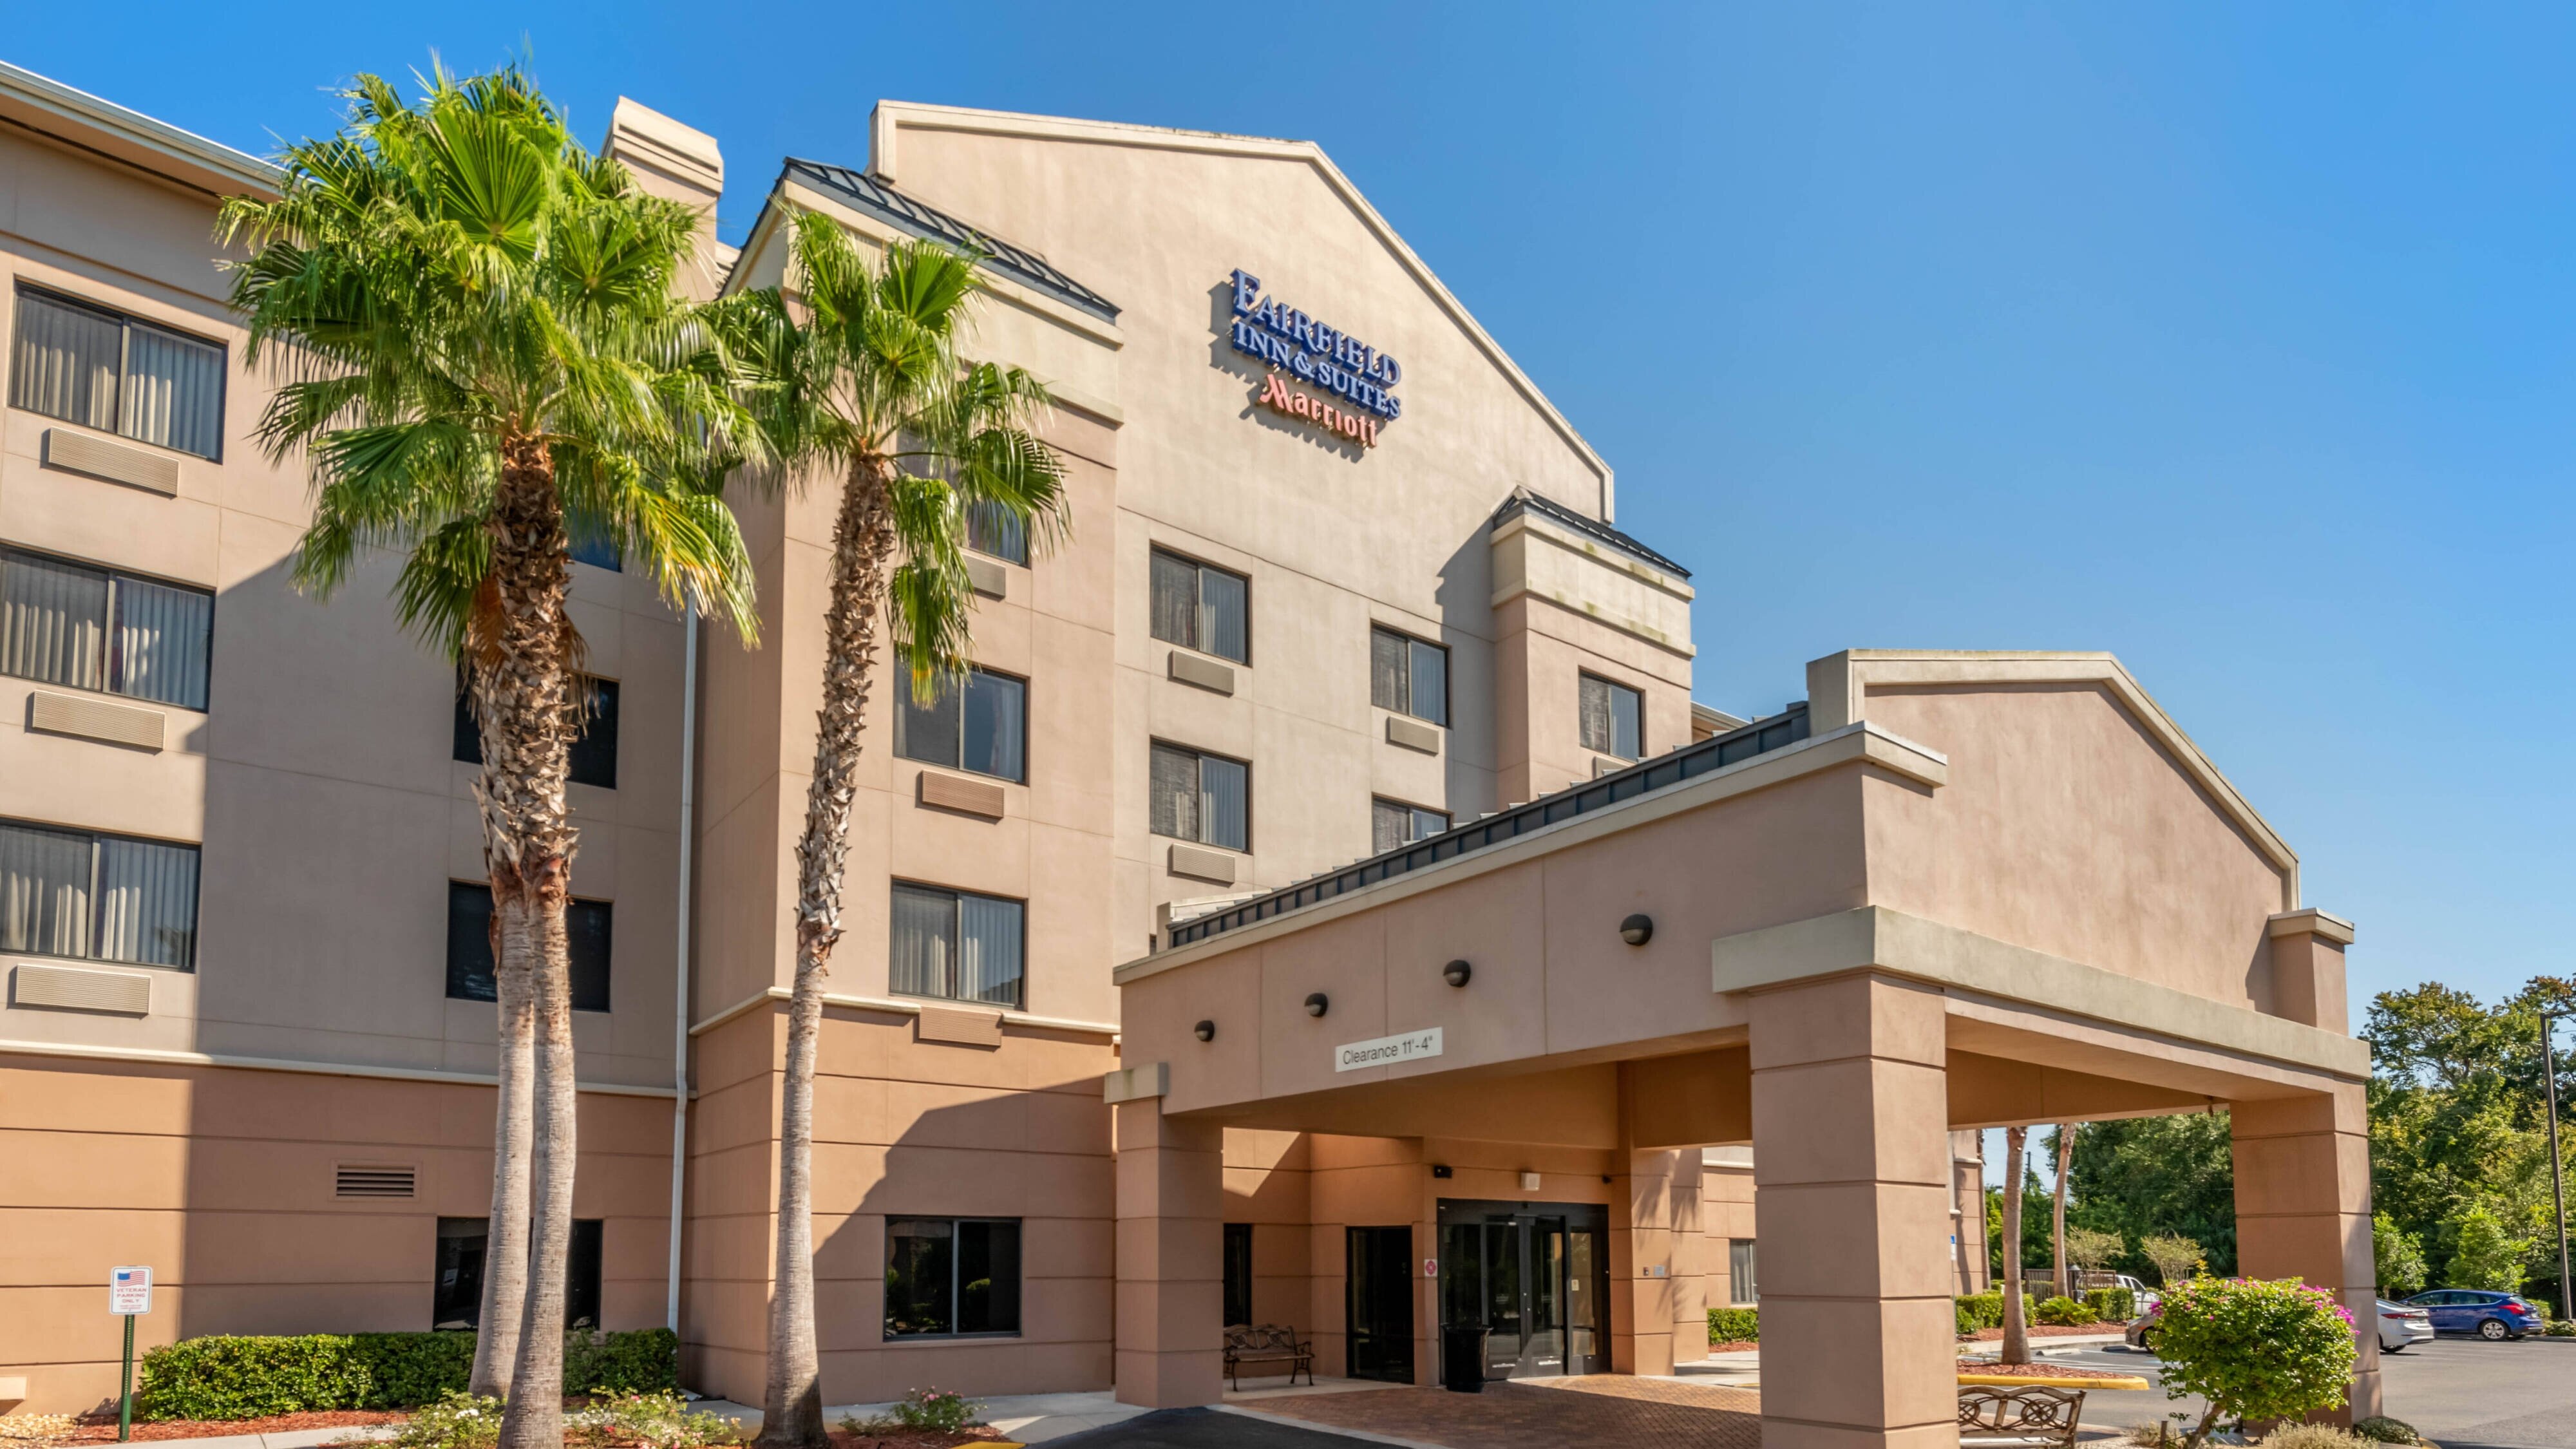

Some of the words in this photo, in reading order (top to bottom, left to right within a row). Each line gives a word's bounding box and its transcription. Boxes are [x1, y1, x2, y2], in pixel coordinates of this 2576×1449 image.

[1229, 268, 1401, 390] FAIRFIELD
[1233, 321, 1291, 371] INN
[1289, 351, 1315, 382] &
[1313, 361, 1401, 422] SUITES
[1258, 374, 1377, 448] Marriott
[1343, 1045, 1398, 1065] Clearance
